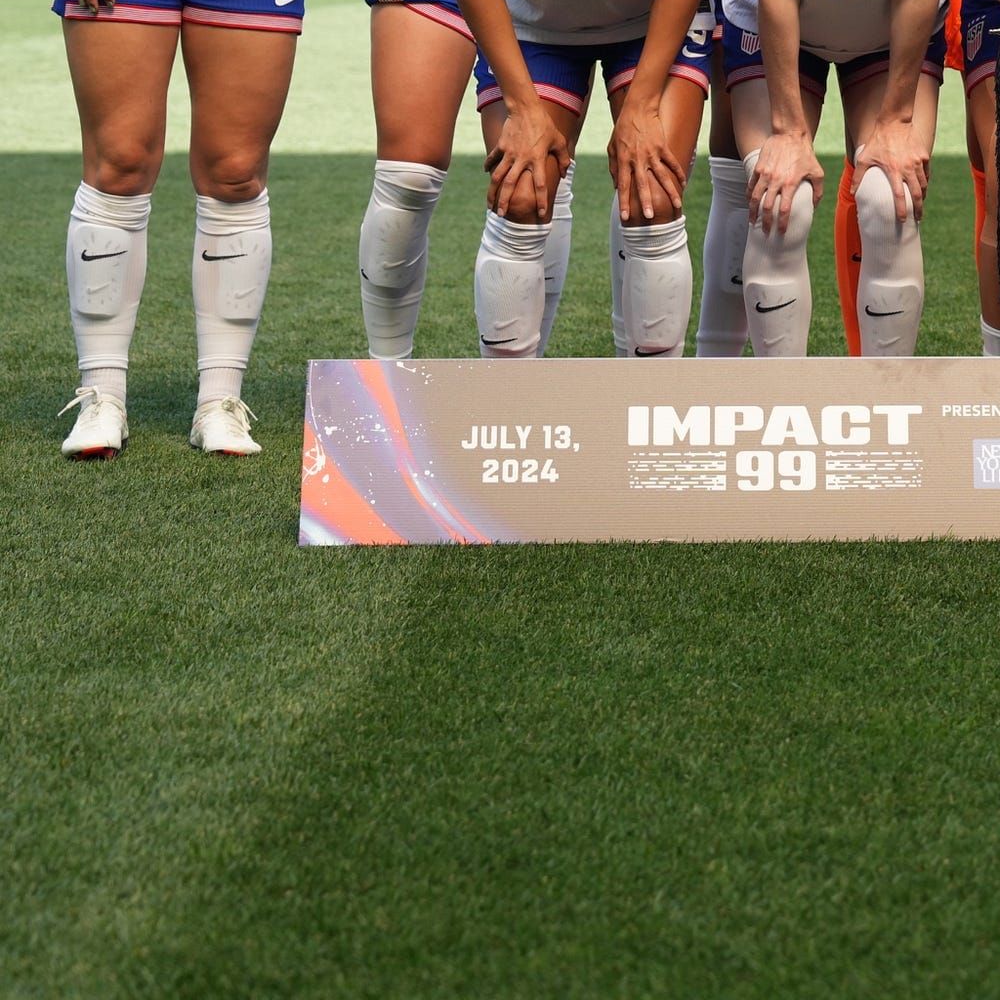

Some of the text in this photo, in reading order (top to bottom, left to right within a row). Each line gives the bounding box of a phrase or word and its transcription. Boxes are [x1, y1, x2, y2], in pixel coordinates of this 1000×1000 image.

[461, 425, 580, 452] JULY 13,
[628, 405, 923, 445] IMPACT
[482, 459, 559, 483] 2024
[736, 450, 817, 491] 99
